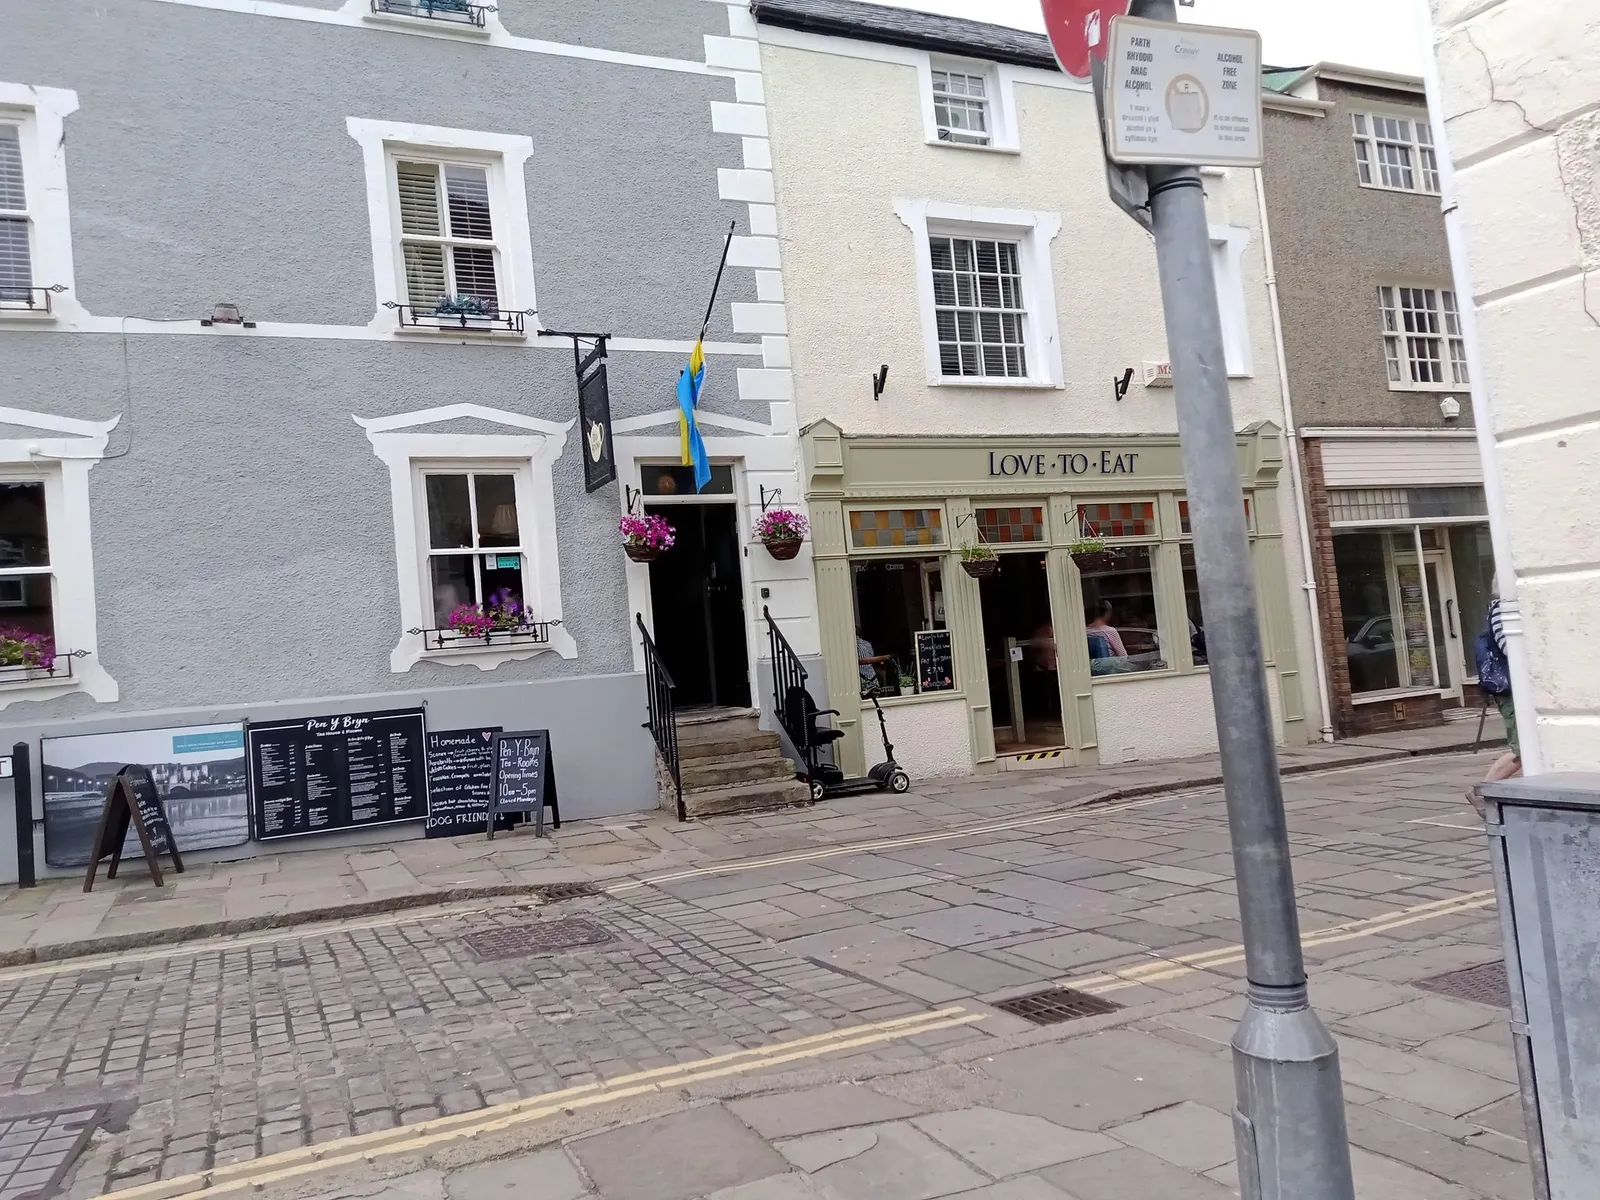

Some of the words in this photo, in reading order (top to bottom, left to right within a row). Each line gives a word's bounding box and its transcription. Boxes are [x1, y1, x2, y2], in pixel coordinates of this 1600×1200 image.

[1130, 37, 1151, 48] PARTH
[1217, 52, 1243, 63] ALCOHOL
[1130, 66, 1148, 76] RHAG
[1222, 67, 1237, 76] FREE
[1124, 79, 1152, 90] ALCOHOL
[1221, 80, 1237, 90] ZONE
[307, 719, 328, 731] Pen
[330, 717, 340, 731] Y
[342, 716, 370, 729] Bryn
[430, 735, 476, 748] Homemade
[499, 769, 521, 783] Opening
[520, 768, 538, 778] Times
[430, 816, 453, 828] DOG
